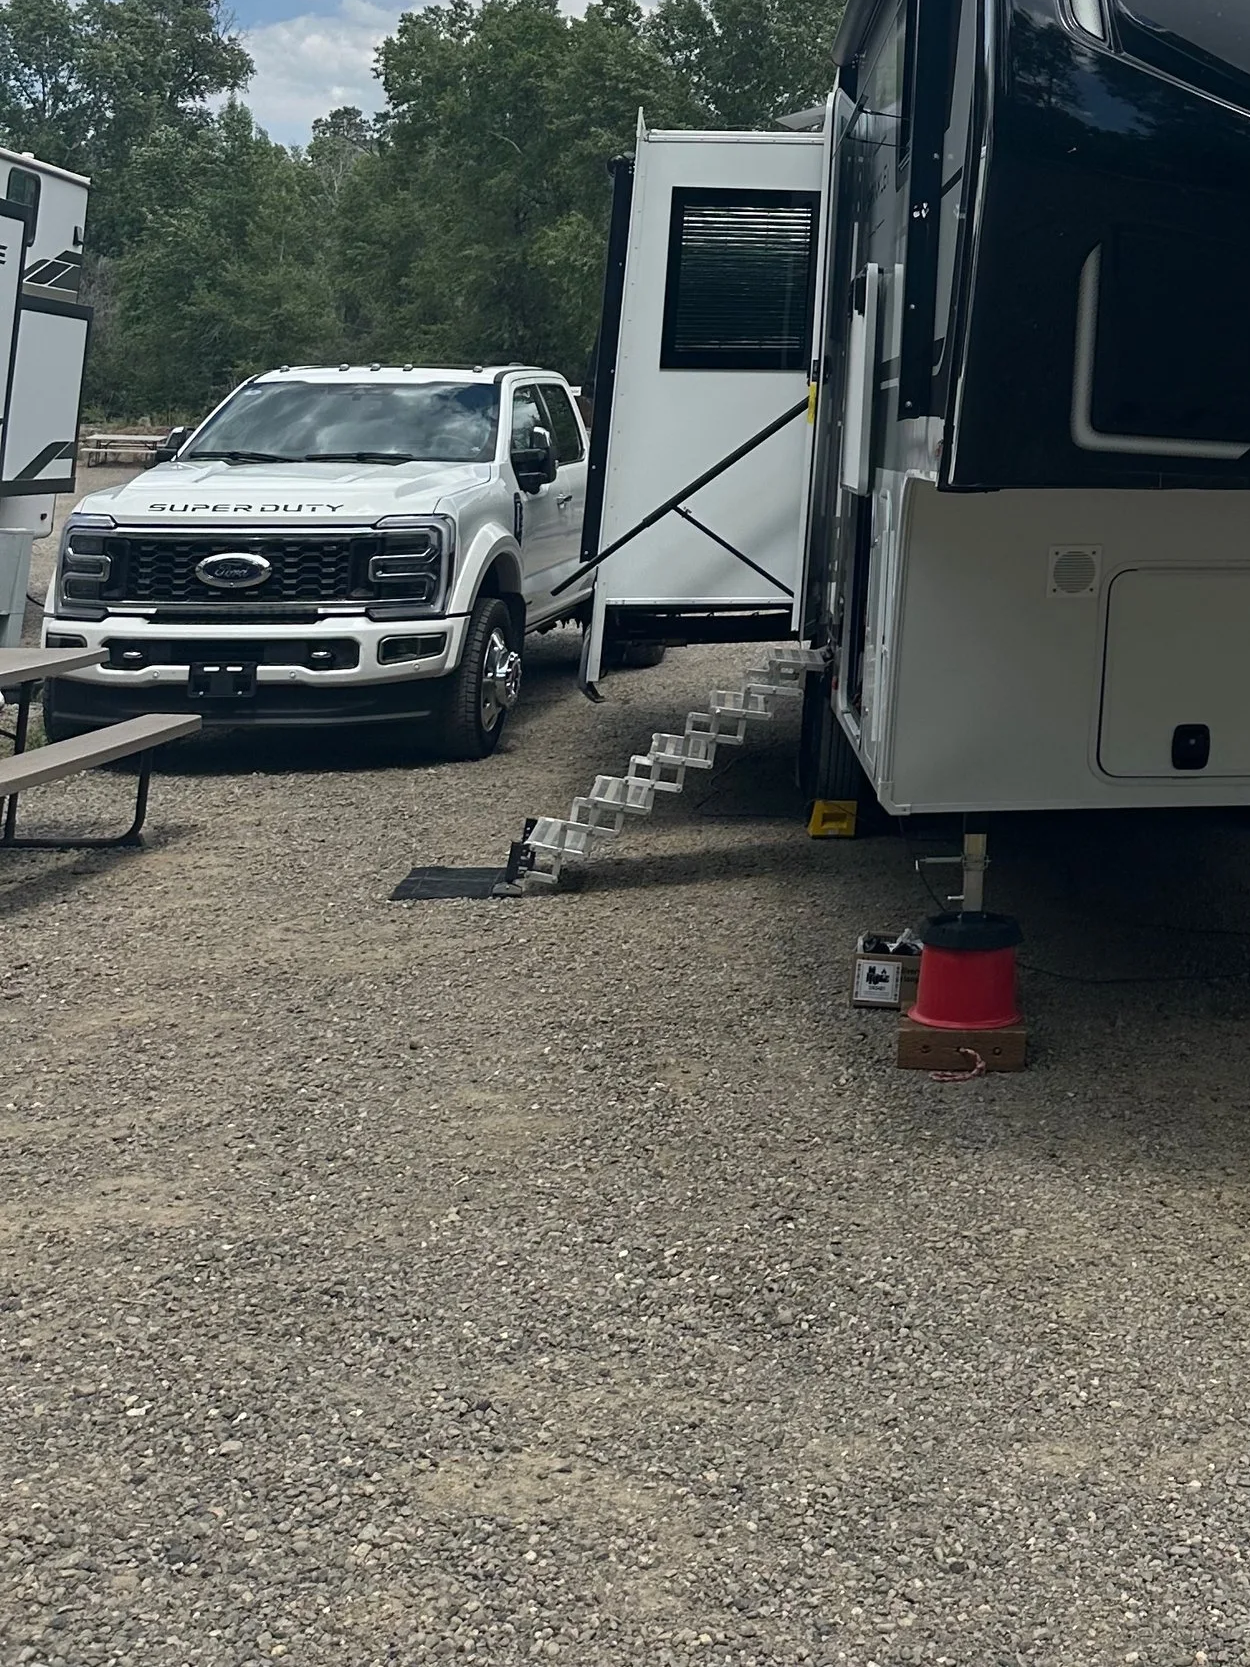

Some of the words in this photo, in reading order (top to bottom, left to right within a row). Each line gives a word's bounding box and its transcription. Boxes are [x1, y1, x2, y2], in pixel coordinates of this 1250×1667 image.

[148, 503, 253, 513] SUPER
[260, 503, 344, 513] DUTY
[214, 562, 250, 578] Ford
